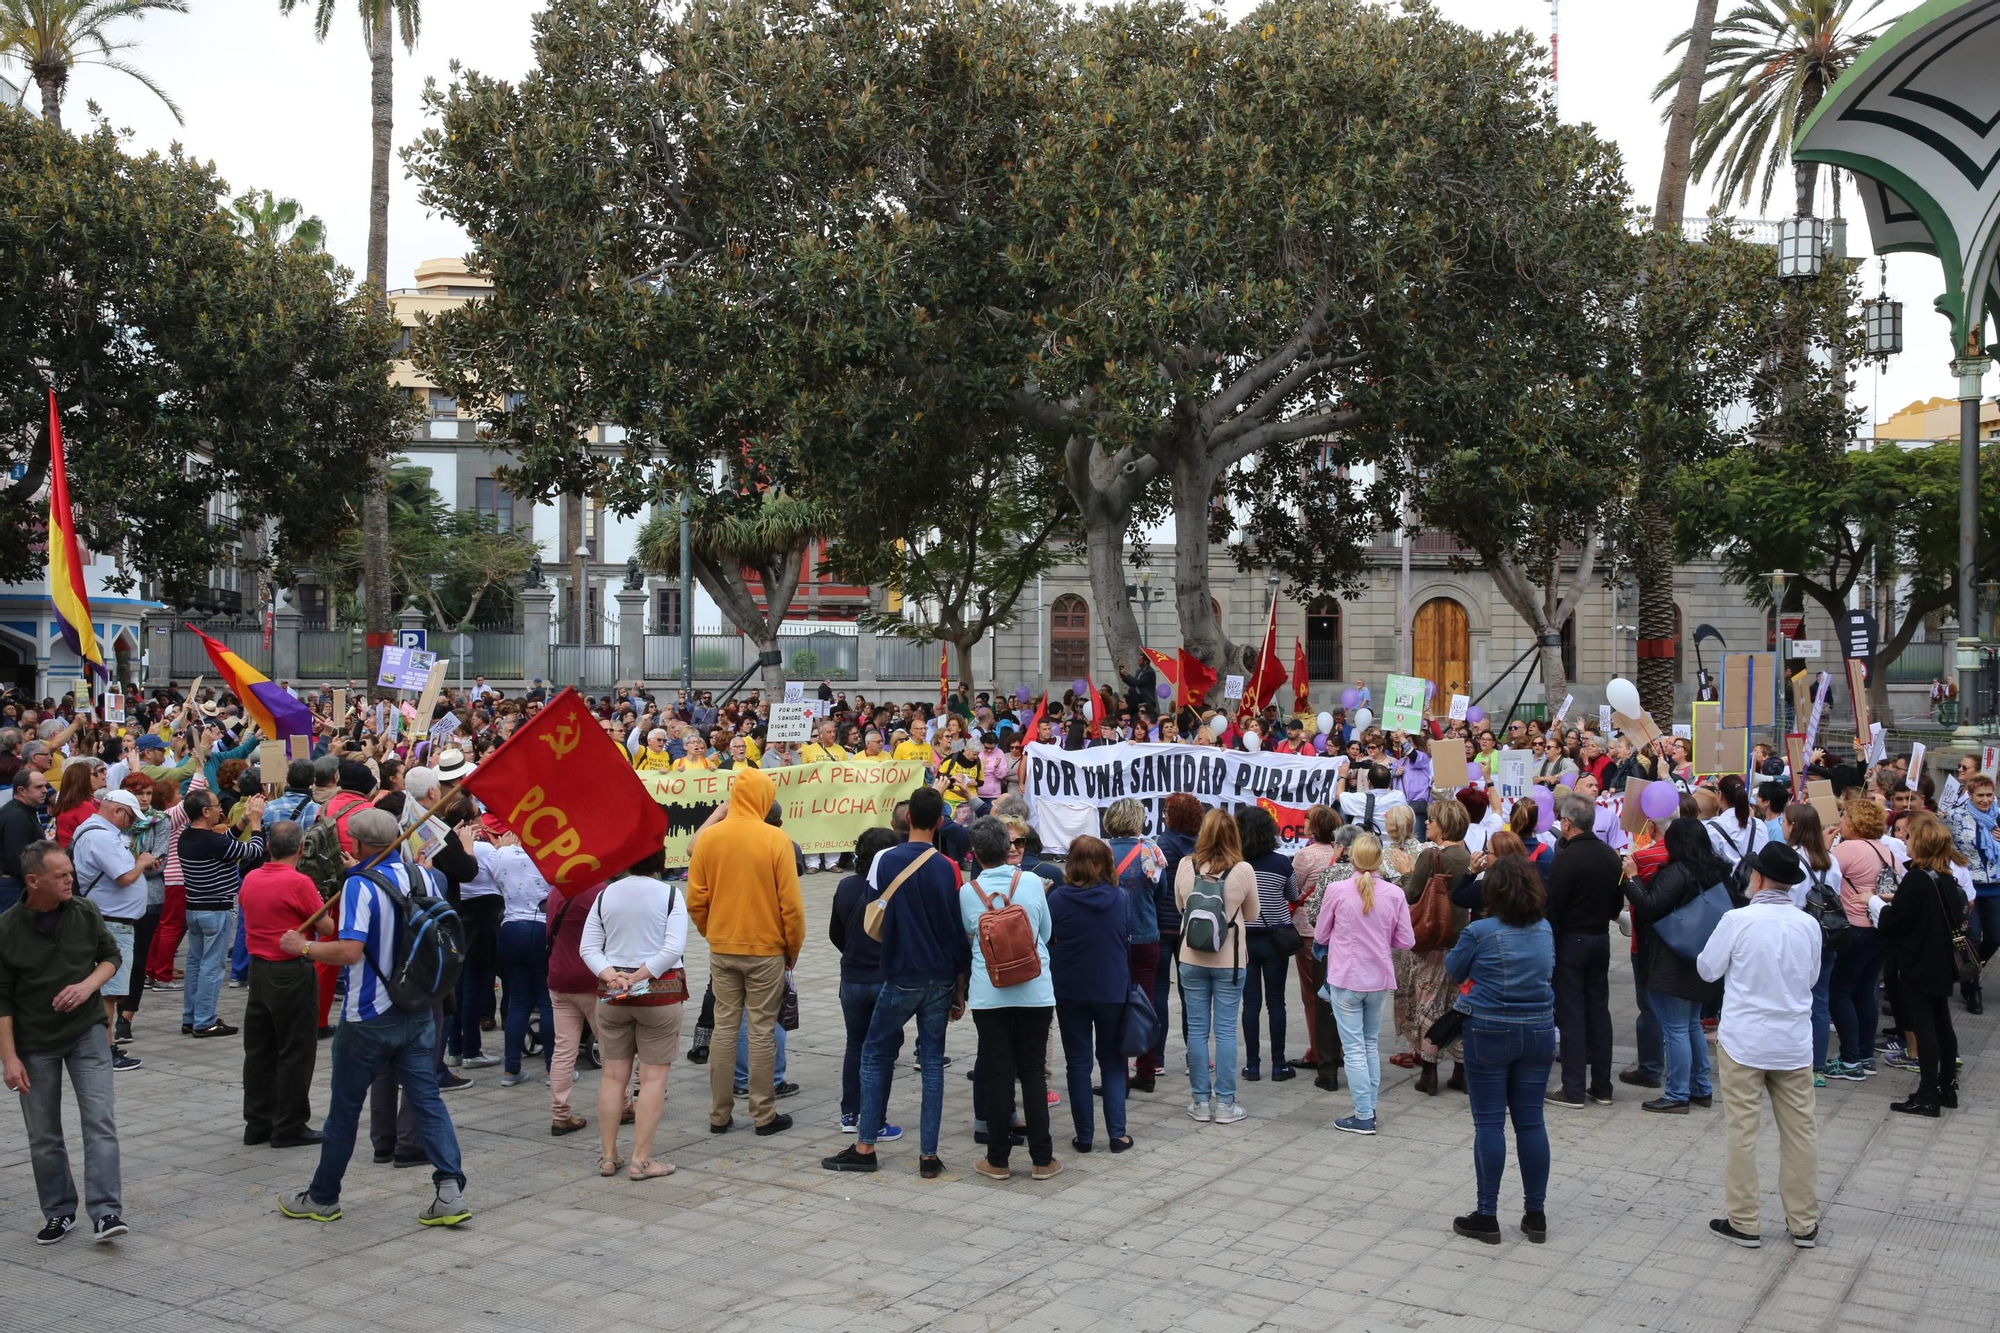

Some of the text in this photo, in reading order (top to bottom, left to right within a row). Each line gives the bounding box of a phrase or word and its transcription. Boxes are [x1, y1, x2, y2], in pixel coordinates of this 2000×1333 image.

[402, 633, 419, 649] P
[656, 779, 686, 795] NO
[694, 777, 718, 794] TE
[797, 768, 822, 784] LA
[831, 762, 911, 784] PENSIÓN
[1032, 754, 1336, 807] POR UNA SANIDAD PUBLICA
[812, 798, 878, 815] LUCHA
[508, 785, 601, 883] PCPC
